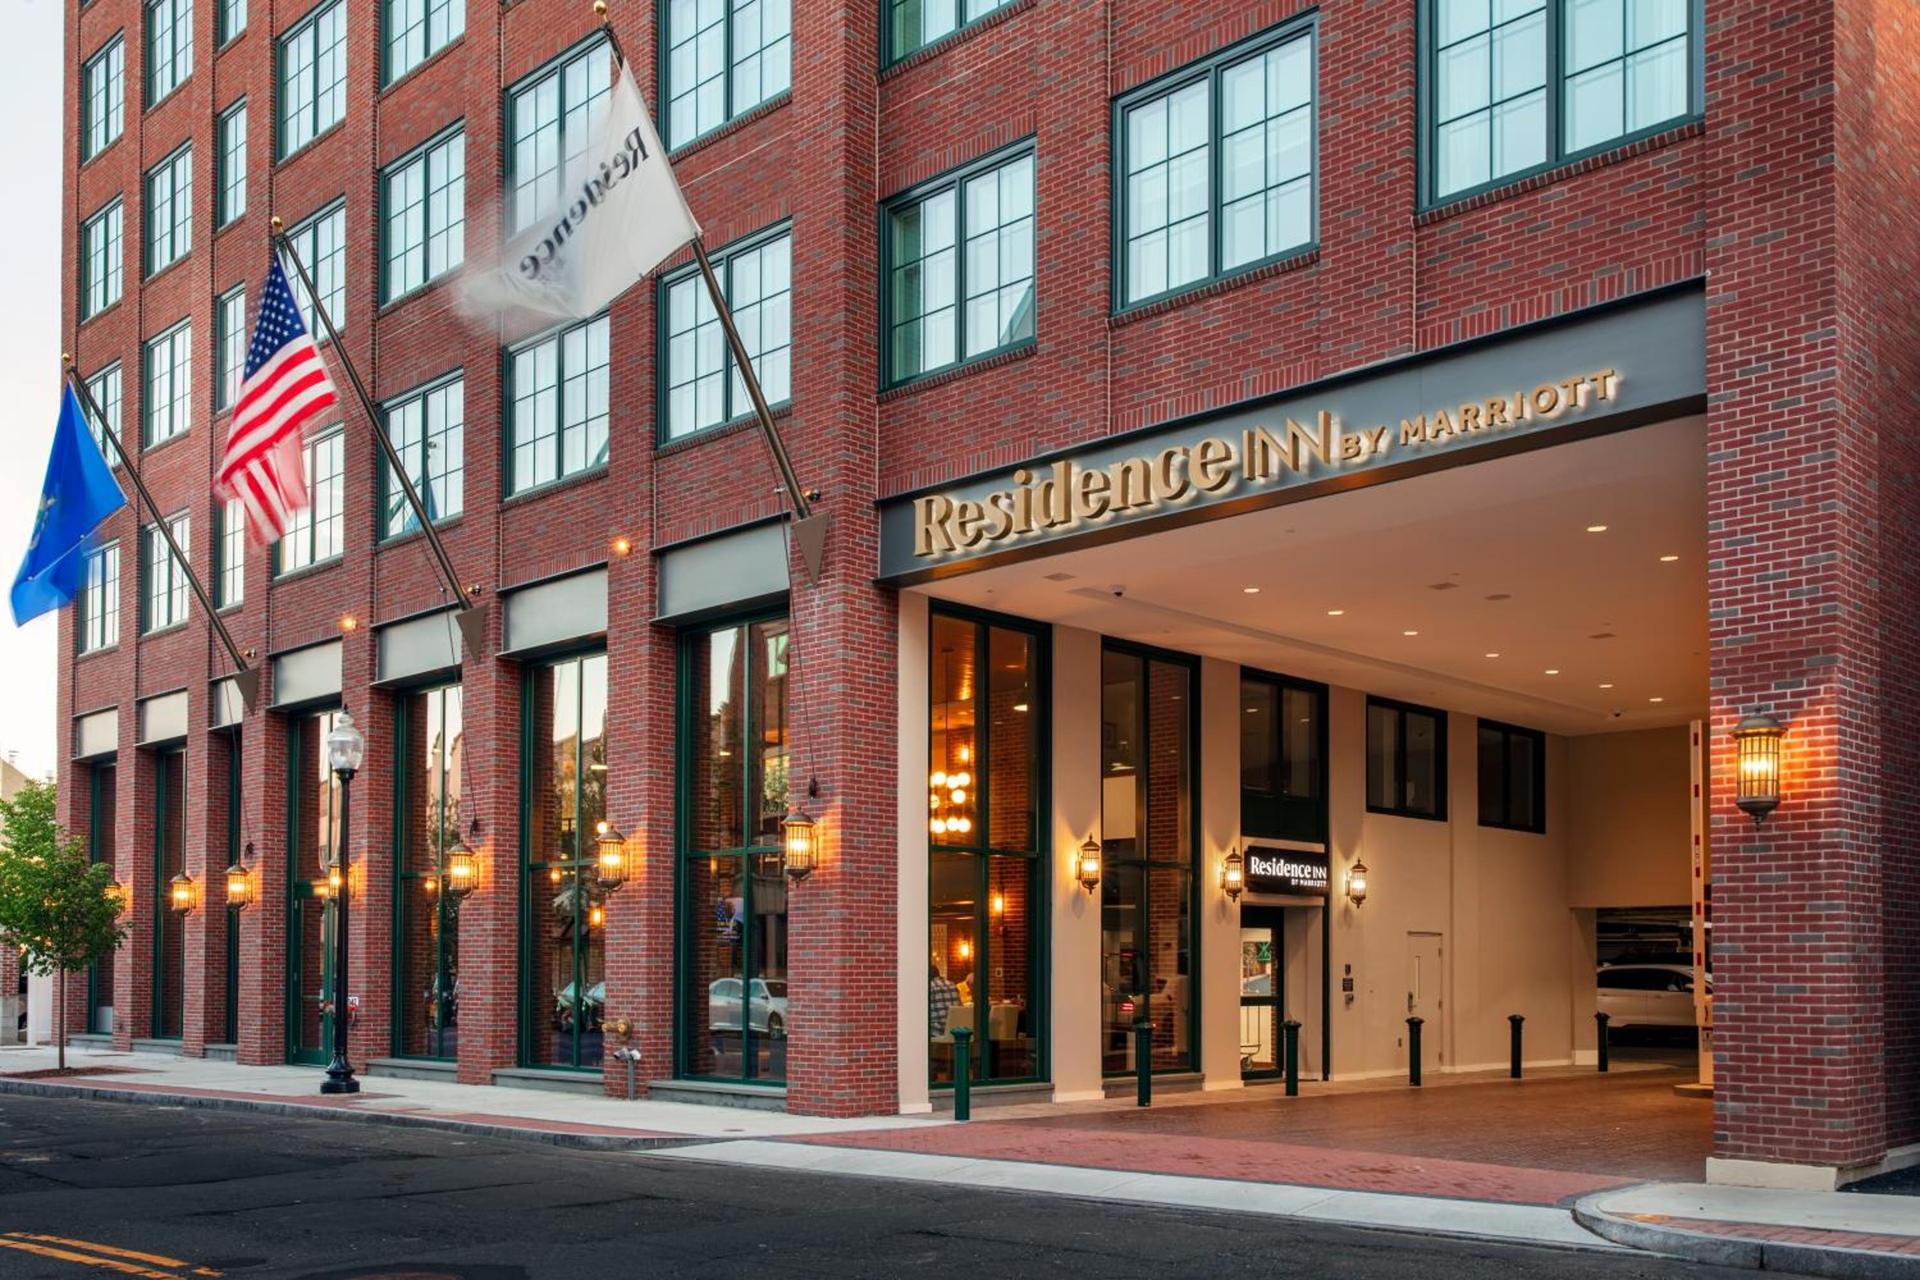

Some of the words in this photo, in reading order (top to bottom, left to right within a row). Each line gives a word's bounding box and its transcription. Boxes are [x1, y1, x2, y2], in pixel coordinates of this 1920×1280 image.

[913, 437, 1232, 556] Residence
[1243, 409, 1332, 480] INN
[1340, 425, 1386, 460] BY
[1399, 368, 1615, 446] MARRIOTT
[1250, 856, 1311, 878] Residence
[1312, 866, 1327, 879] INN
